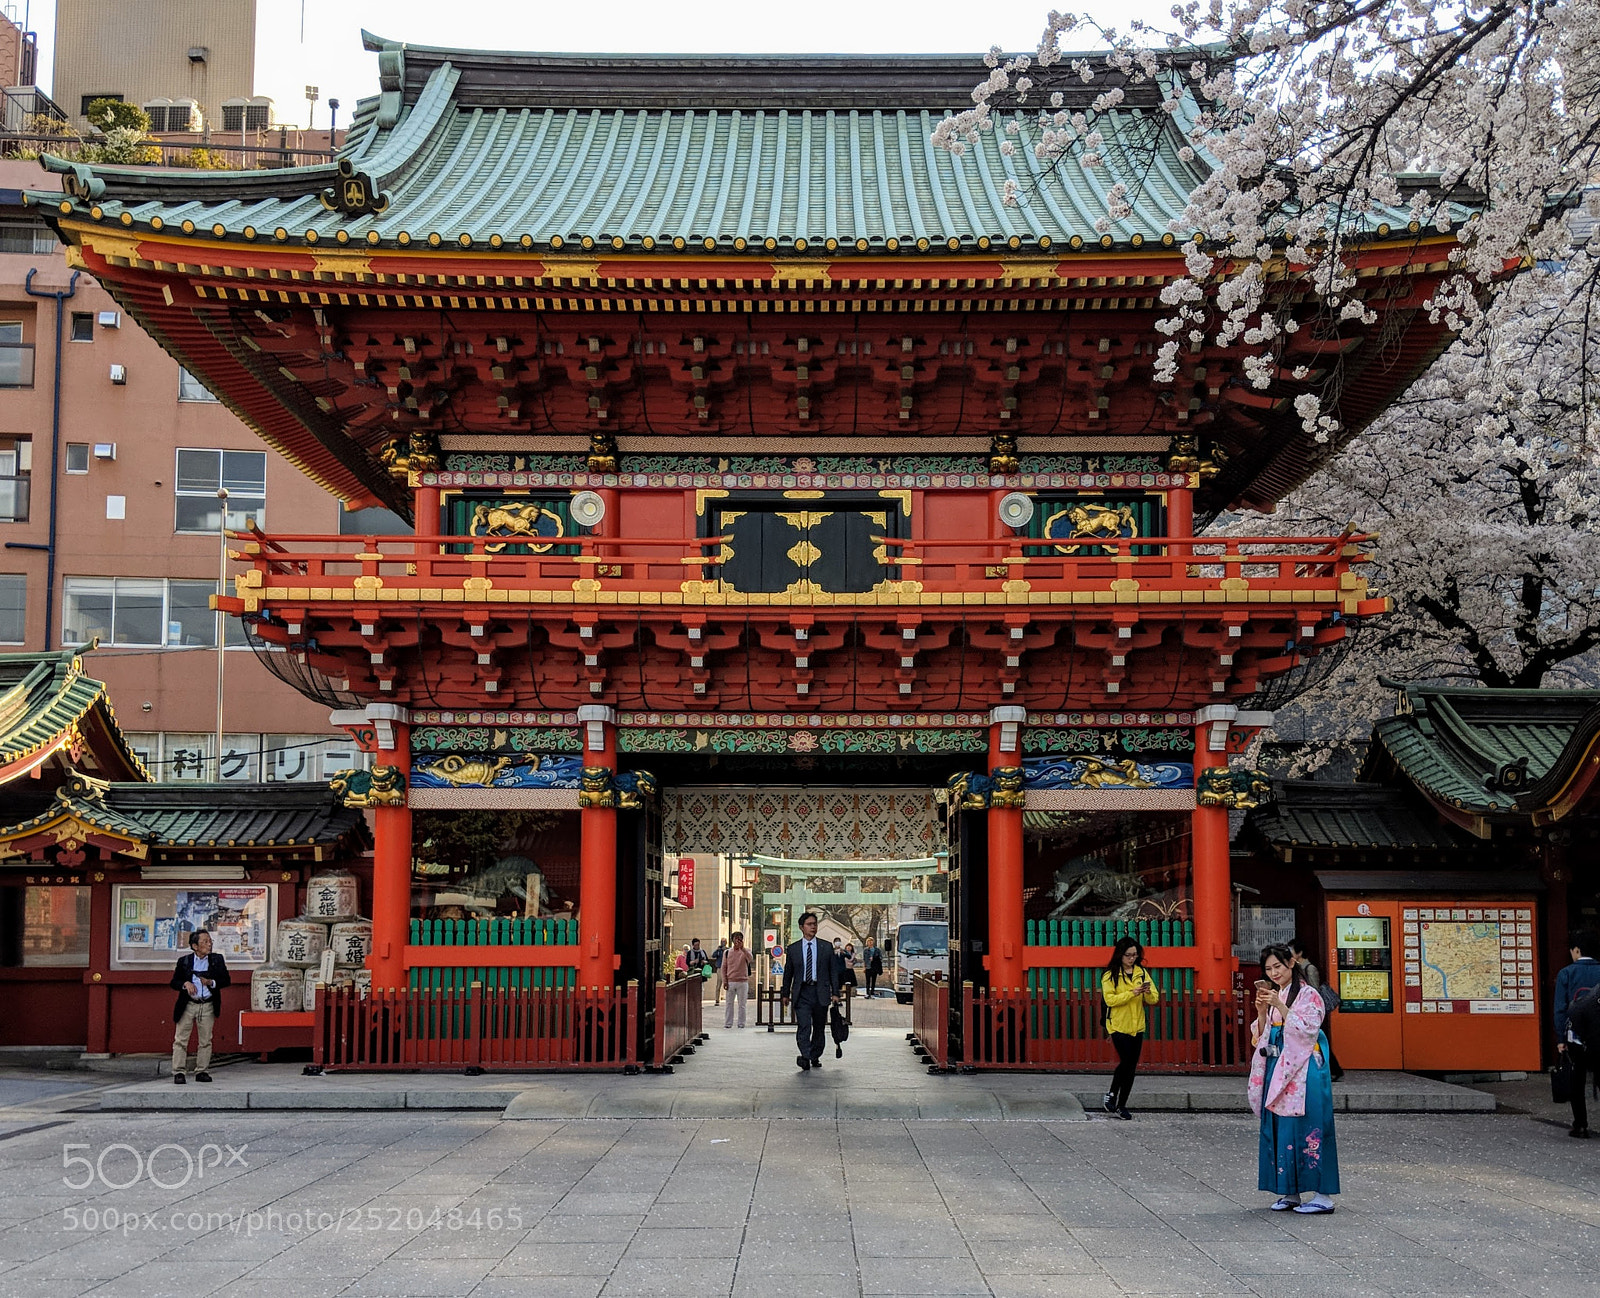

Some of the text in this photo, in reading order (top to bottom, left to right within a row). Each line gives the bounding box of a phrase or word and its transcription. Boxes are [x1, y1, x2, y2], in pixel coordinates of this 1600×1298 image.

[318, 887, 337, 916] 金婚
[287, 931, 308, 961] 金婚
[345, 935, 366, 963] 金婚
[264, 980, 284, 1010] 金婚
